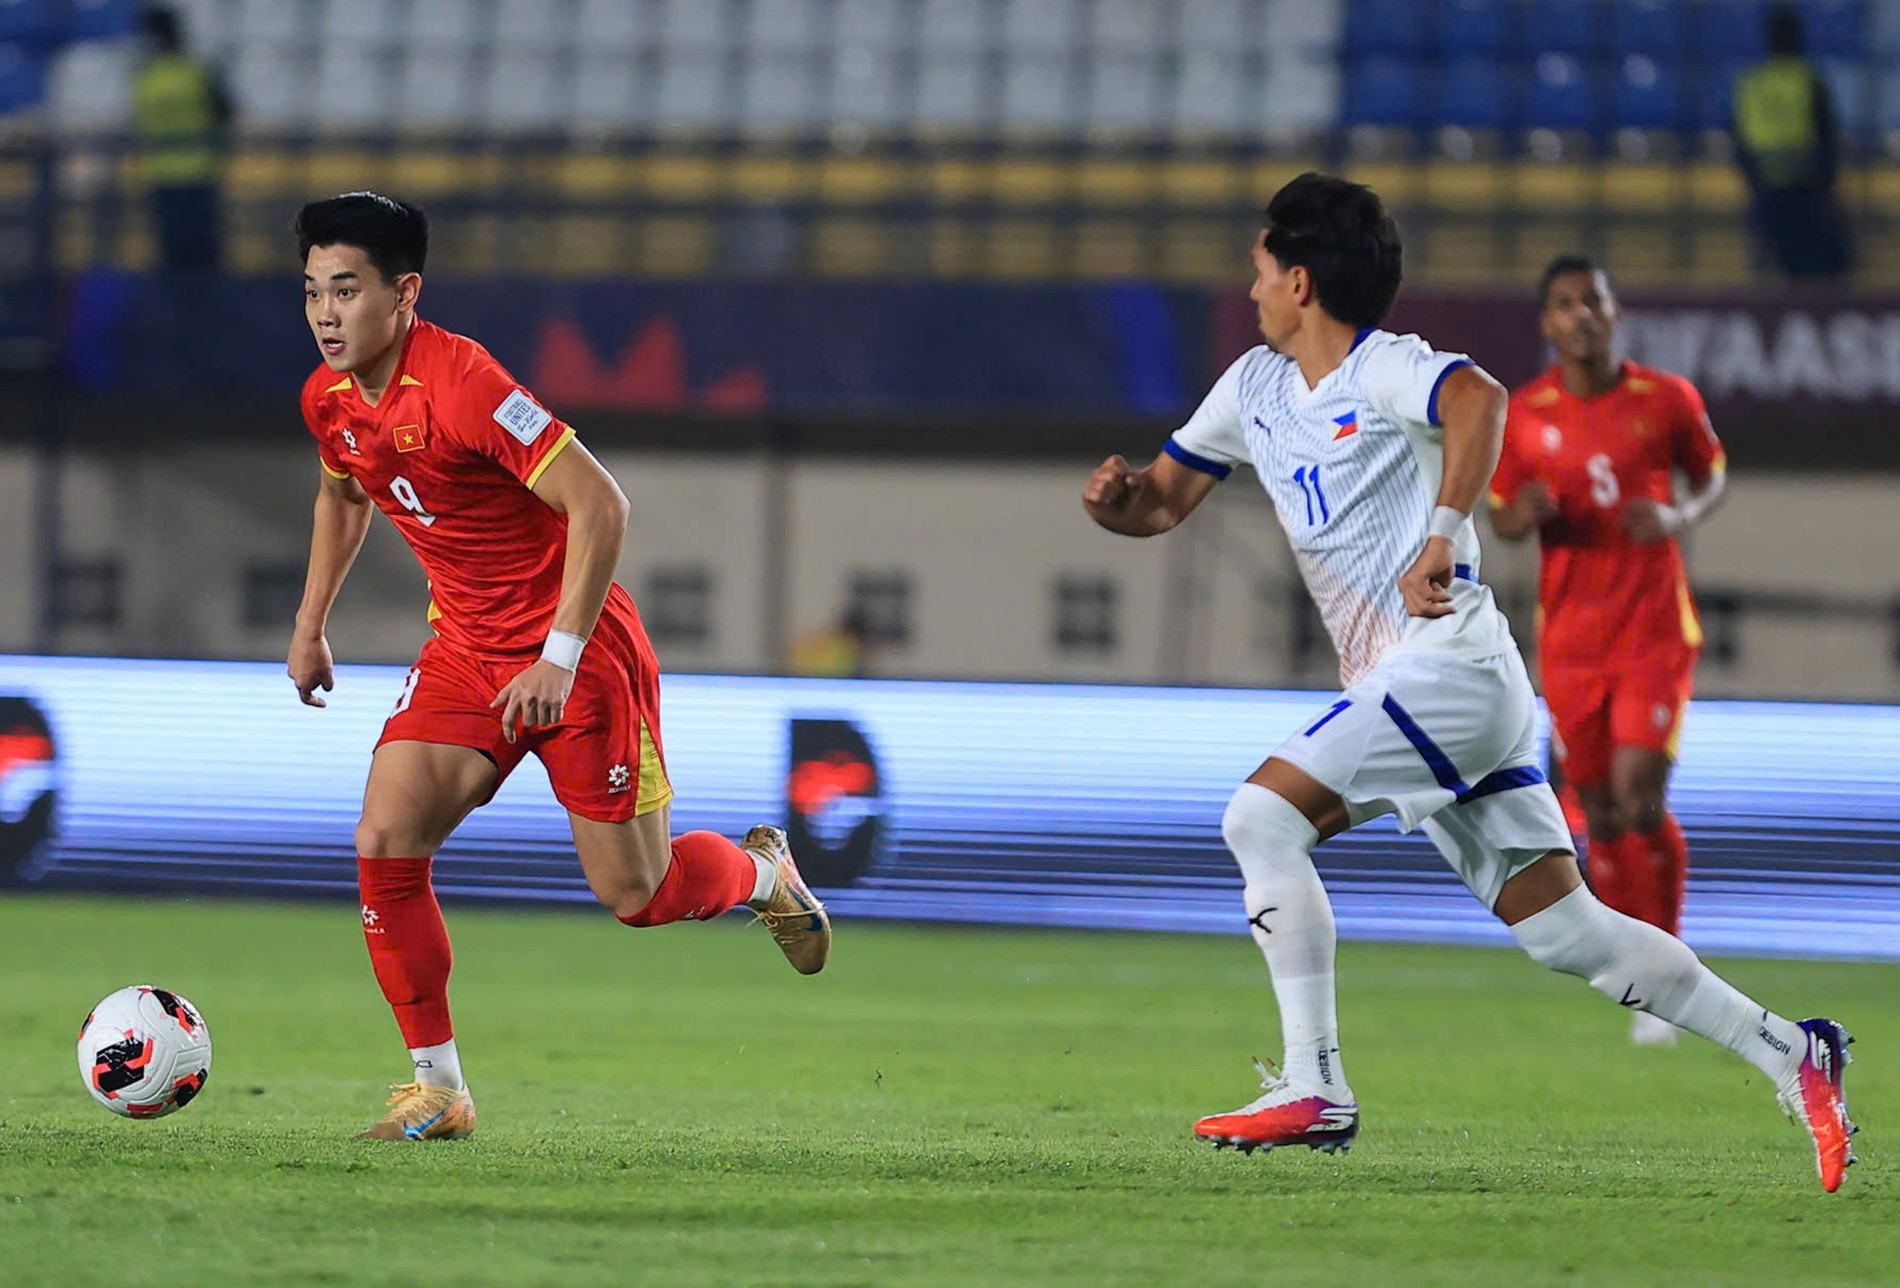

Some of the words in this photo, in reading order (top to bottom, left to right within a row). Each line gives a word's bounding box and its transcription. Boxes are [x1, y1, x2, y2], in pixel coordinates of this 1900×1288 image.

[509, 402, 531, 425] UNITES
[389, 475, 436, 527] 9
[1293, 464, 1329, 526] 11
[1587, 453, 1620, 508] 5
